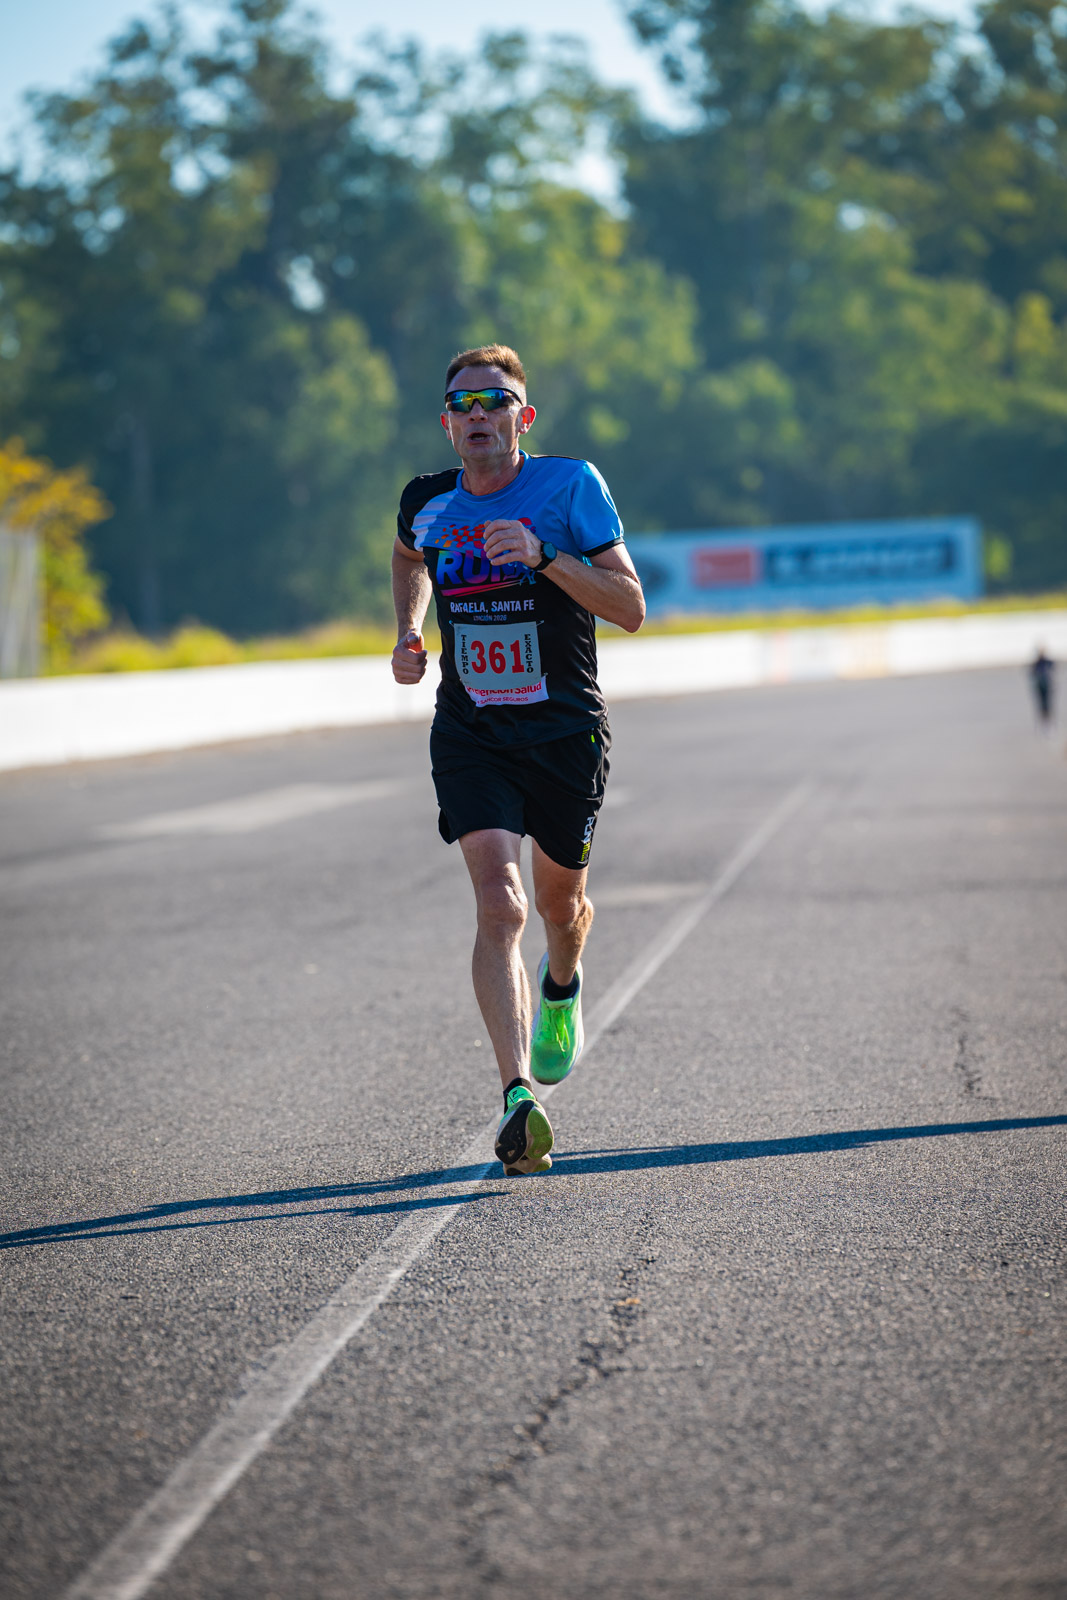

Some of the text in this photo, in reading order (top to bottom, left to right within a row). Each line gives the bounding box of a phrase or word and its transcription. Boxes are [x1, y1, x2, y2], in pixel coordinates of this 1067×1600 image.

[449, 599, 535, 613] RAFAELA, SANTA FE
[461, 634, 469, 675] TIEMPO
[470, 640, 525, 674] 361
[524, 634, 534, 673] EXACTO
[515, 682, 542, 695] Salud
